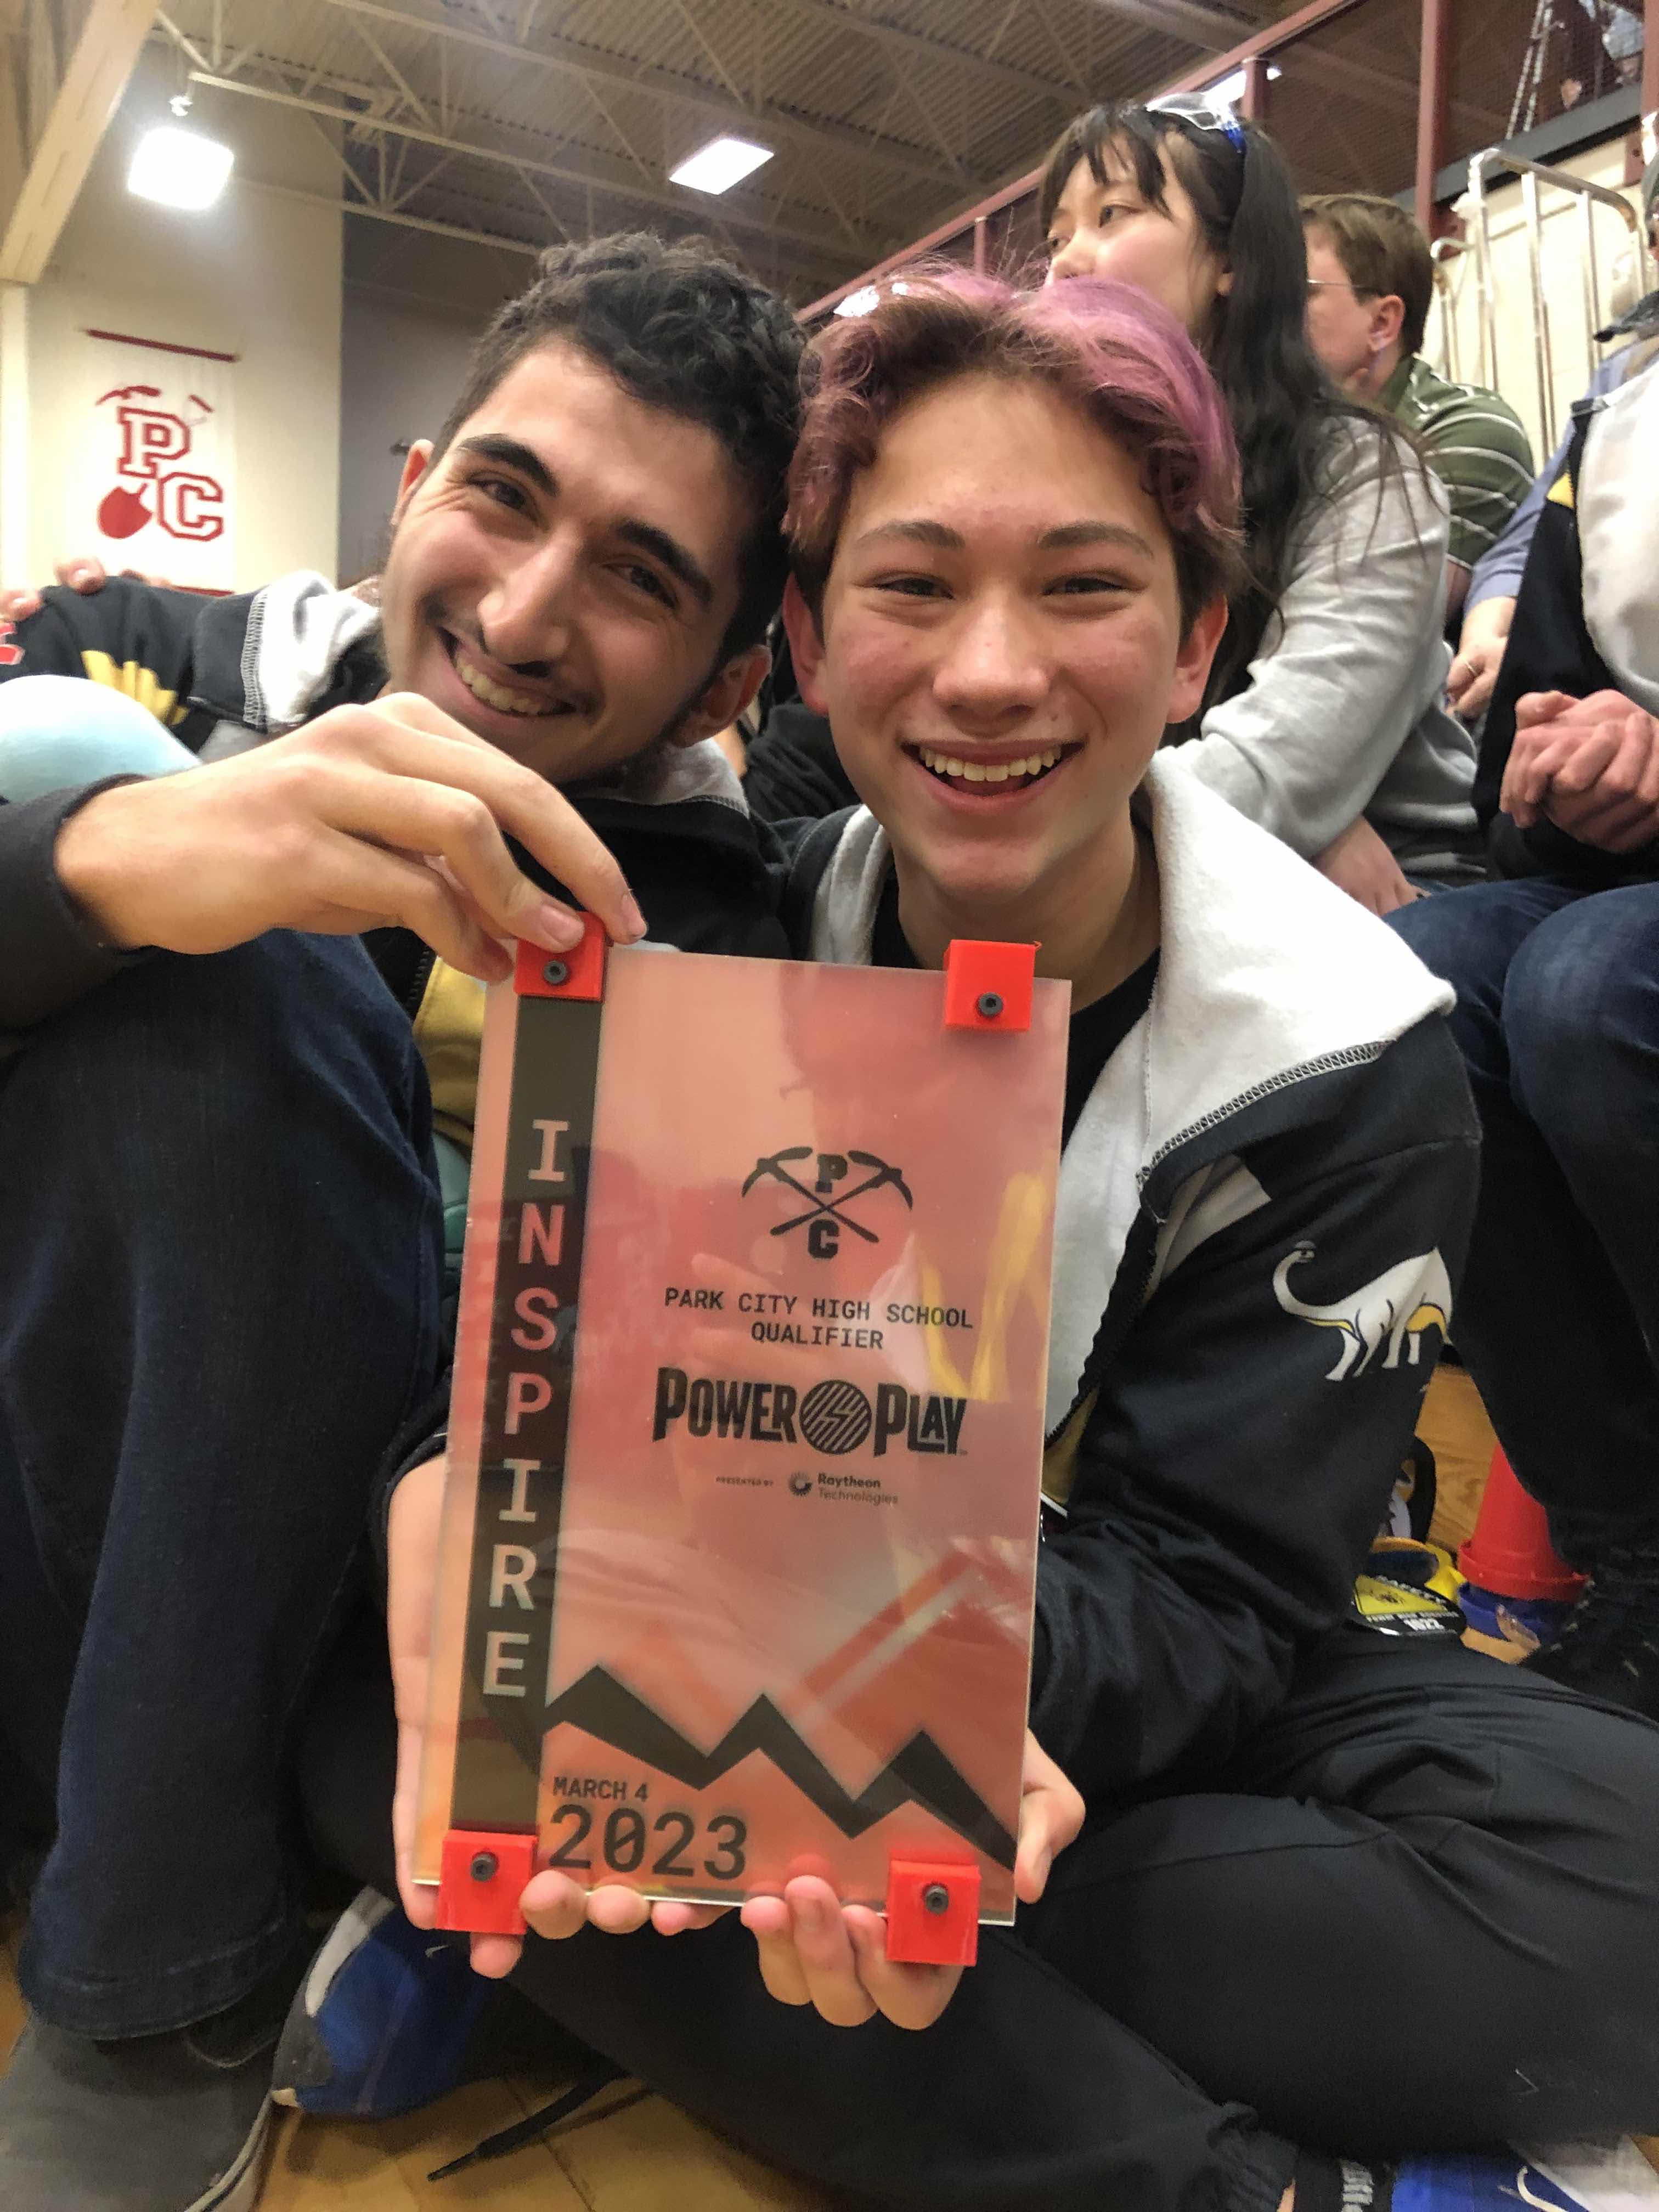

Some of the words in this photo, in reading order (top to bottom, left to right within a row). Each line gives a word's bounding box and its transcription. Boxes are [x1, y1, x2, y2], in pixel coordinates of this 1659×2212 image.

[664, 1287, 724, 1310] PARK
[738, 1293, 798, 1314] CITY
[812, 1298, 870, 1321] HIGH
[887, 1304, 973, 1329] SCHOOL
[751, 1322, 883, 1349] QUALIFIER
[483, 1119, 569, 1697] INSPIRE
[652, 1366, 798, 1443] POWER
[873, 1382, 967, 1458] PLAY
[818, 1472, 881, 1488] Raytheon
[820, 1487, 899, 1505] Technologies
[553, 1775, 629, 1801] MARCH
[634, 1782, 650, 1802] 4
[549, 1804, 748, 1880] 2023
